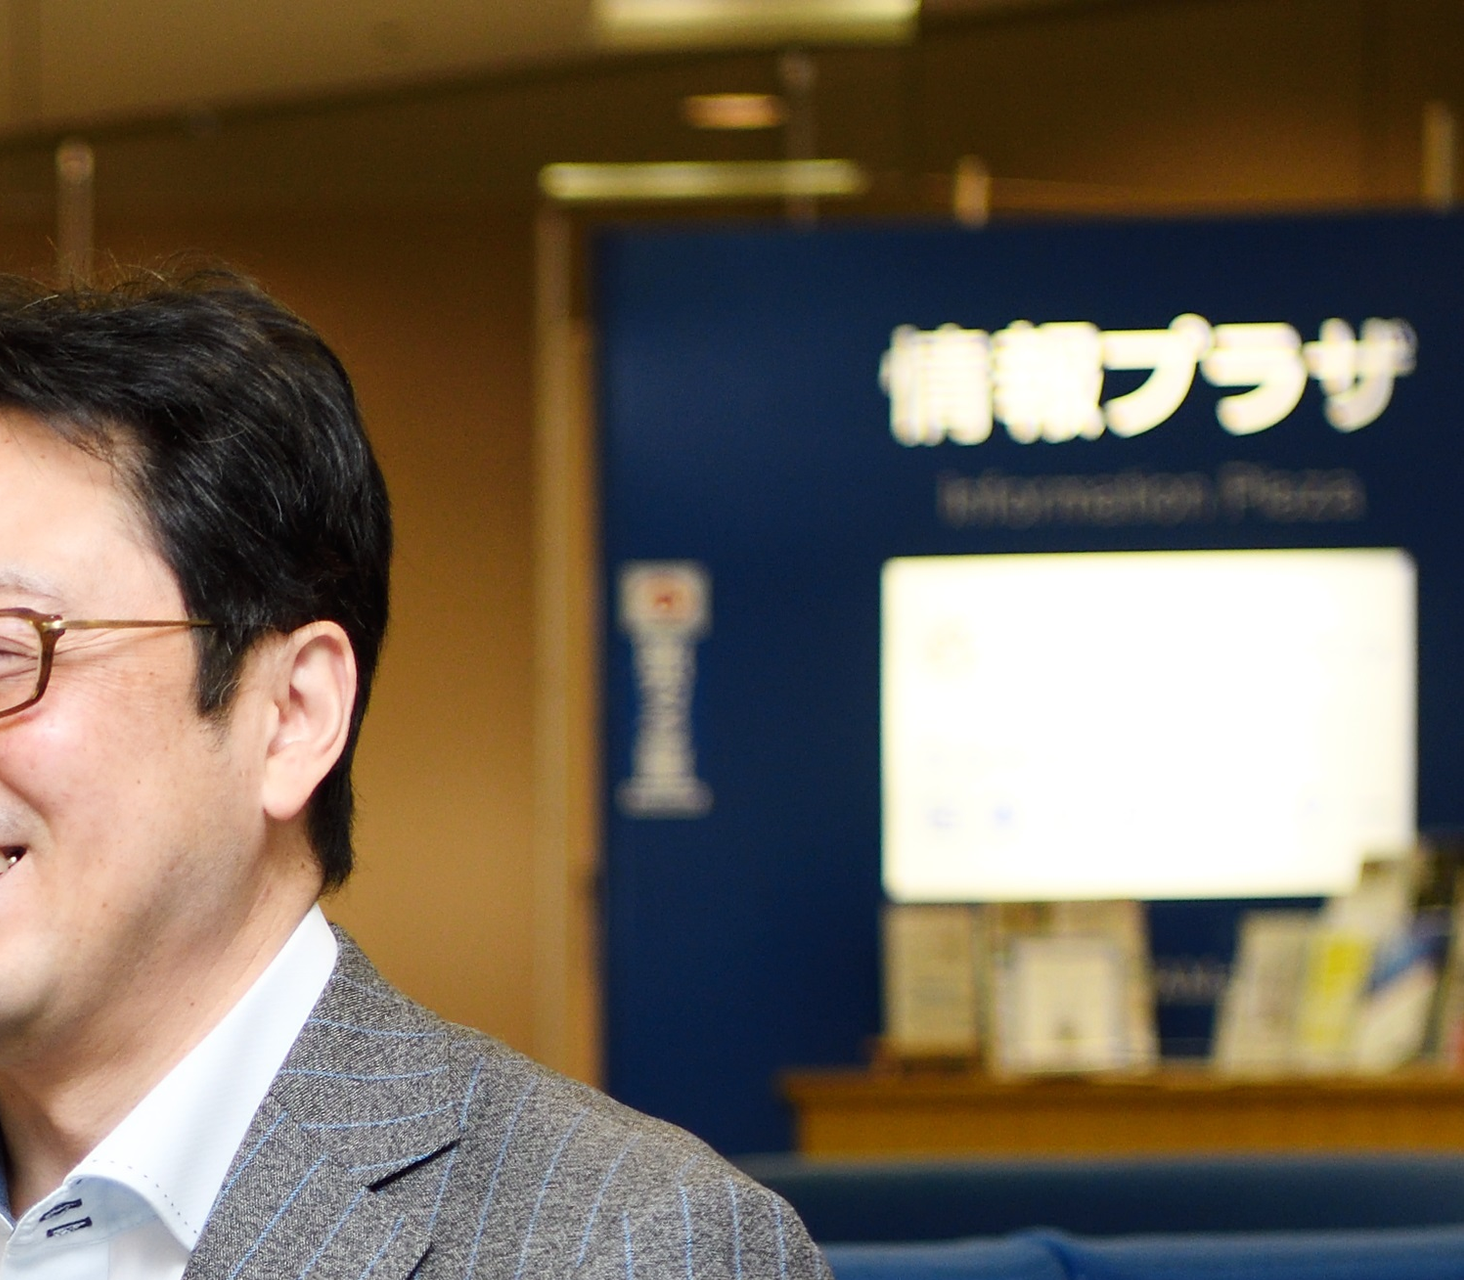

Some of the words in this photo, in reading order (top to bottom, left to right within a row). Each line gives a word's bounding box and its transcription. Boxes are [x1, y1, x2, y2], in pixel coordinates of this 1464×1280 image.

[880, 313, 1417, 446] 情報プラザ
[937, 470, 1213, 527] Information
[1217, 463, 1368, 521] Plaza
